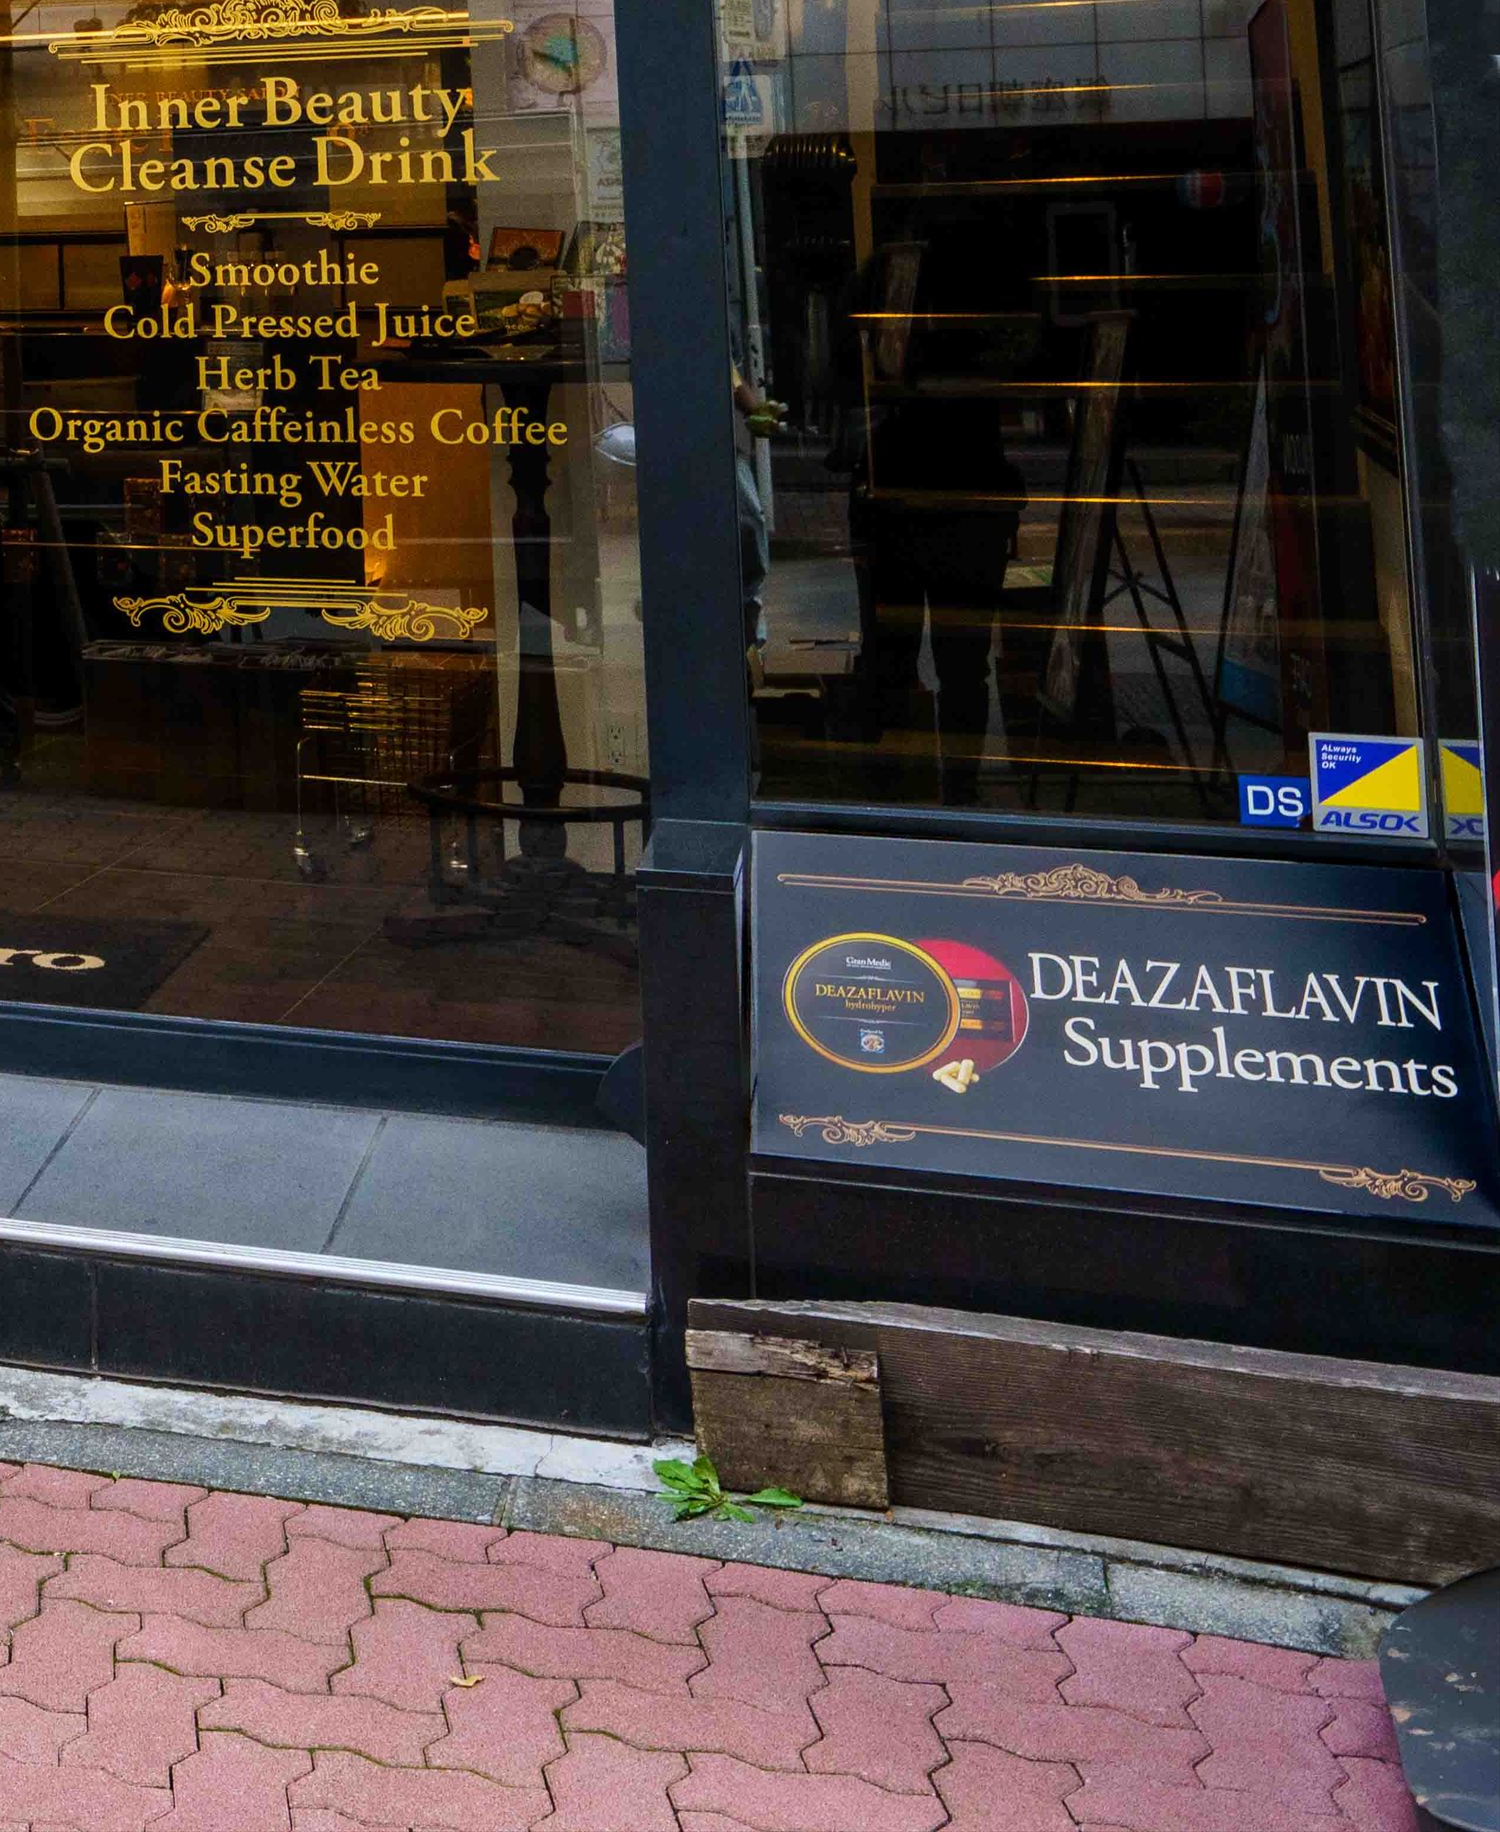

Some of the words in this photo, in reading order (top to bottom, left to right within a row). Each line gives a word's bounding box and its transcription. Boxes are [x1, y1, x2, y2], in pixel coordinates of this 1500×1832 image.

[90, 83, 249, 132] Inner
[262, 76, 468, 138] Beauty
[69, 139, 298, 193] Cleanse
[312, 129, 500, 187] Drink
[188, 249, 380, 291] Smoothie
[103, 304, 198, 340] Cold
[212, 301, 361, 340] Pressed
[371, 302, 477, 346] Juice
[194, 354, 298, 393] Herb
[308, 355, 383, 393] Tea
[29, 406, 185, 454] Organic
[197, 406, 416, 446] Caffeinless
[430, 407, 569, 446] Coffee
[158, 458, 303, 505] Fasting
[308, 461, 428, 499] Water
[191, 511, 397, 559] Superfood
[1321, 752, 1362, 764] Security
[1321, 760, 1337, 770] OK
[1246, 784, 1304, 817] DS
[1319, 810, 1420, 833] ALSOK
[815, 983, 926, 1004] DEAZAFLAVIN
[1028, 951, 1443, 1032] DEAZAFLAVIN
[1062, 1016, 1461, 1100] Supplements
